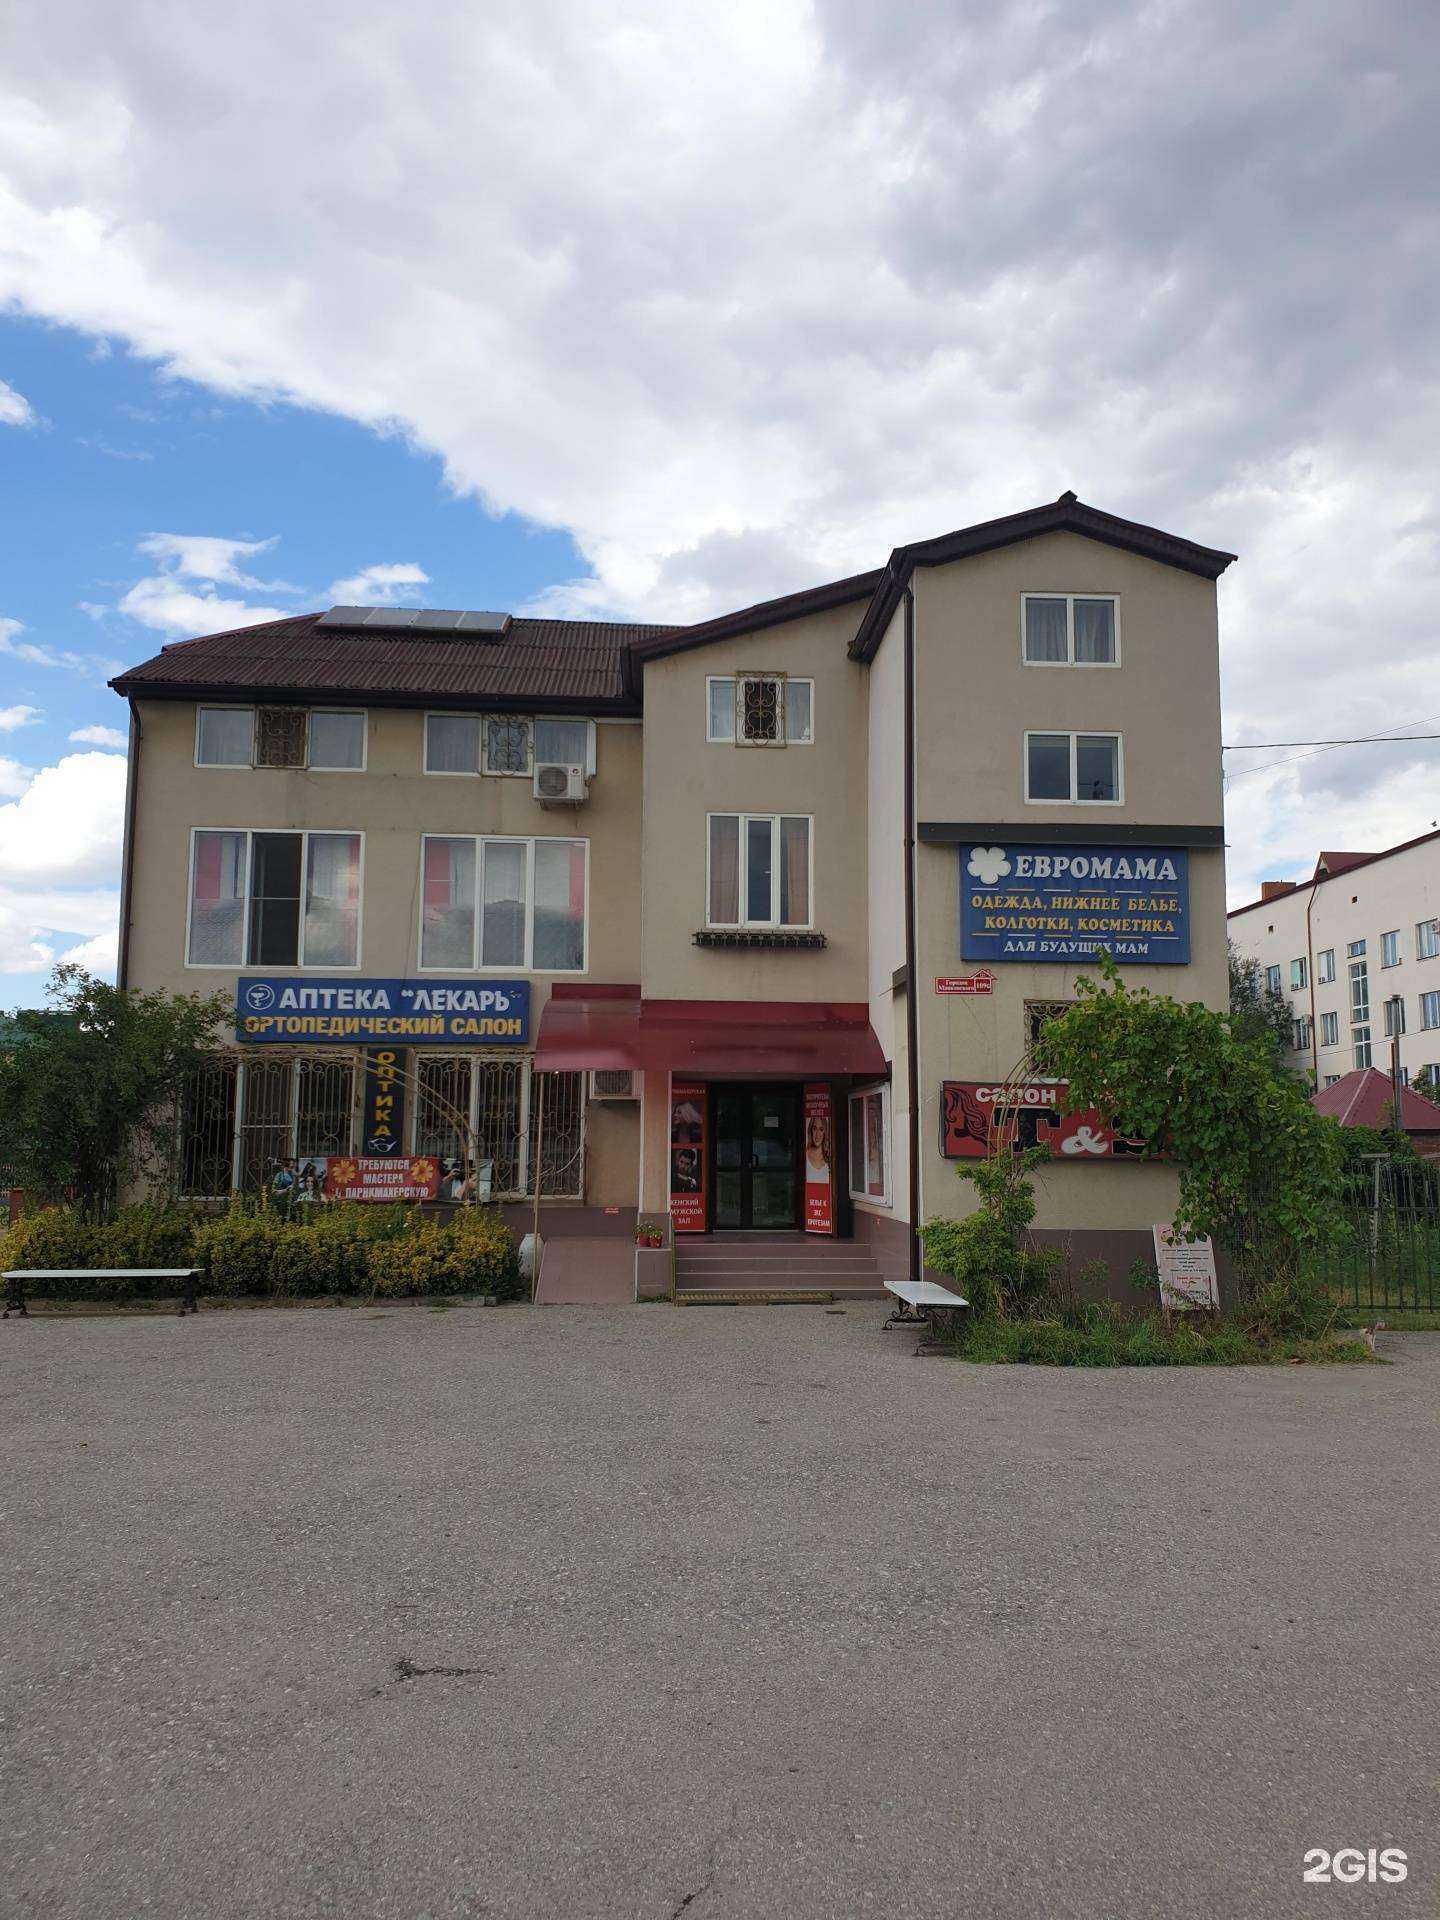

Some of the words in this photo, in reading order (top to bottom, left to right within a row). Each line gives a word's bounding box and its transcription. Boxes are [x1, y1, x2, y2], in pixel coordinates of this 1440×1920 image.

[1014, 855, 1178, 881] ЕВРОМАМА
[971, 895, 1047, 911] ОДЕЖДА,
[1051, 896, 1120, 910] НИЖНЕЕ
[1127, 898, 1183, 914] БЕЛЬЕ,
[984, 916, 1074, 932] КОЛГОТКИ,
[1078, 917, 1175, 933] КОСМЕТИКА
[1003, 940, 1036, 954] ДЛЯ
[1115, 942, 1149, 954] МАМ
[279, 988, 391, 1010] АПТЕКА
[245, 1014, 445, 1036] ОРТОПЕДИЧЕСКИЙ
[450, 1017, 522, 1036] САЛОН
[375, 1051, 396, 1137] ОПТИКА
[358, 1159, 409, 1171] ТРЕБУЮТСЯ
[363, 1173, 404, 1184] МАСТЕРА
[345, 1186, 429, 1199] ПАРИКМАХЕРСКУЮ
